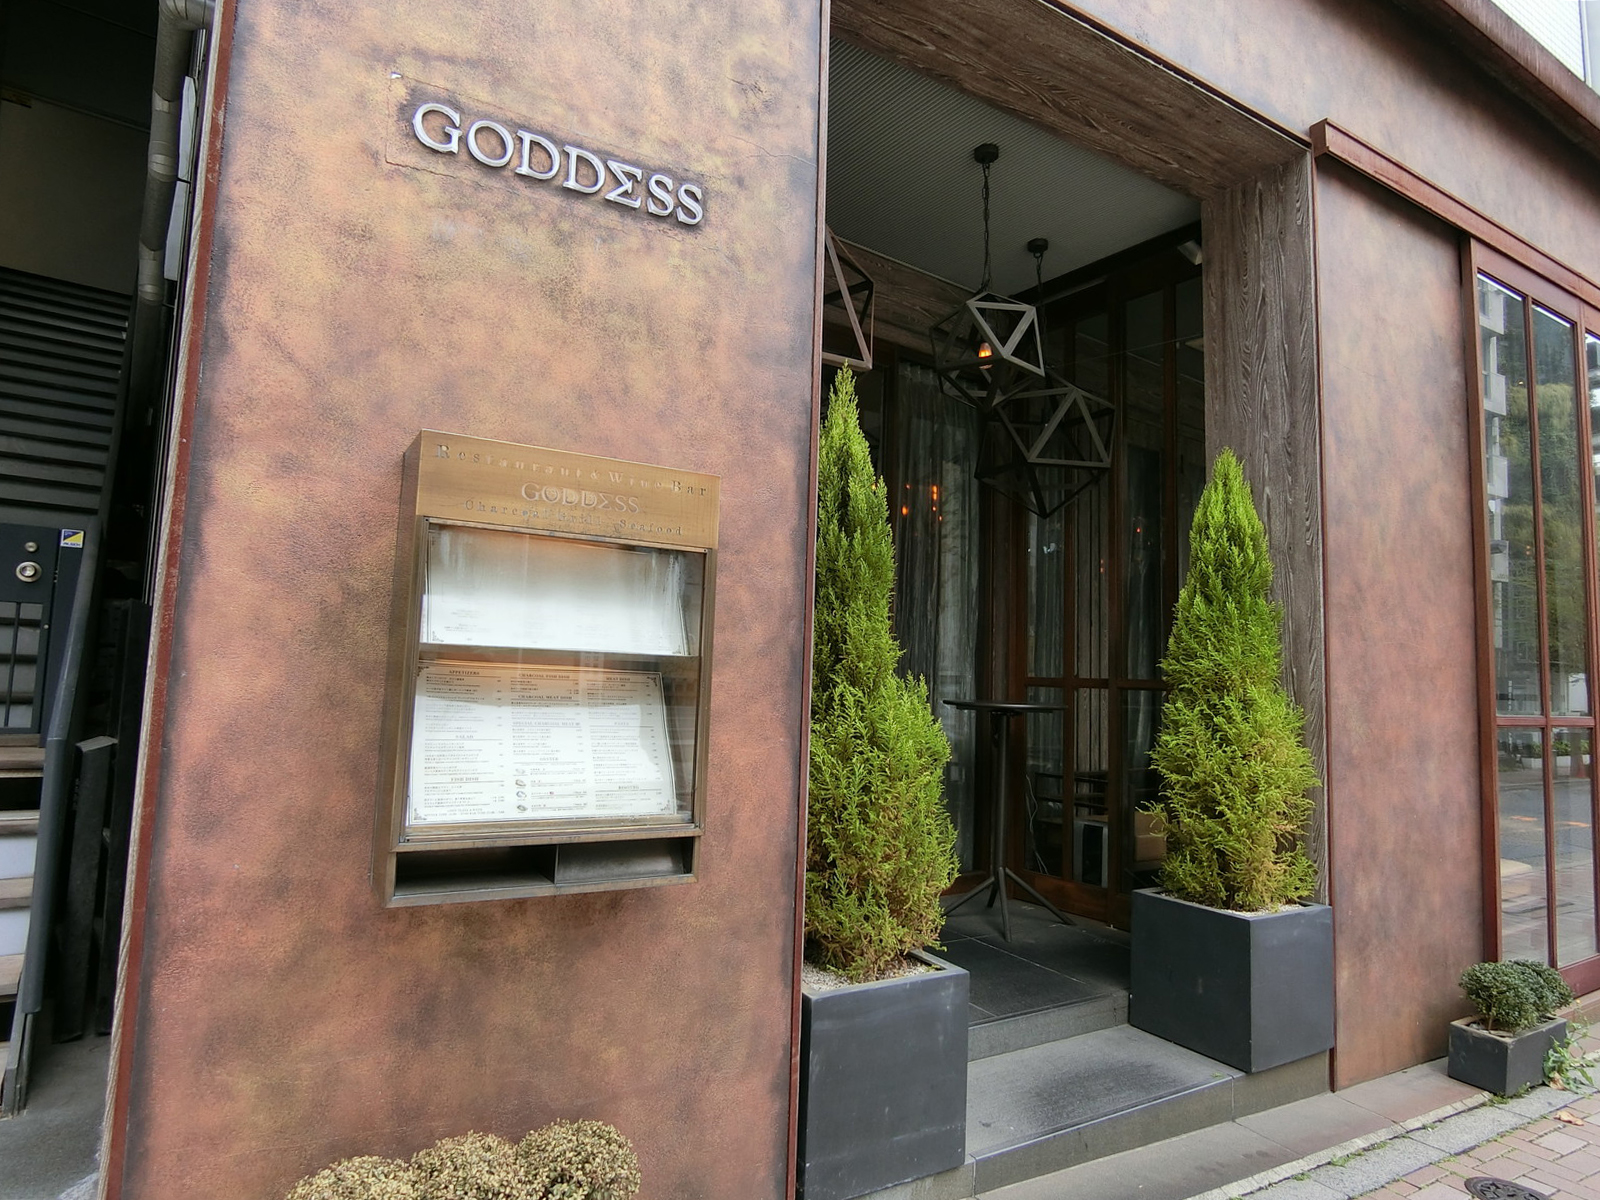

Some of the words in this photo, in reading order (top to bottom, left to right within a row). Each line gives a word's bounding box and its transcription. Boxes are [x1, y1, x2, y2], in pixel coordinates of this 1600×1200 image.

[436, 444, 581, 478] Restaurant
[608, 471, 663, 489] Wine
[671, 480, 707, 496] Bar
[464, 500, 551, 520] Charcoal
[619, 519, 682, 536] Seafood
